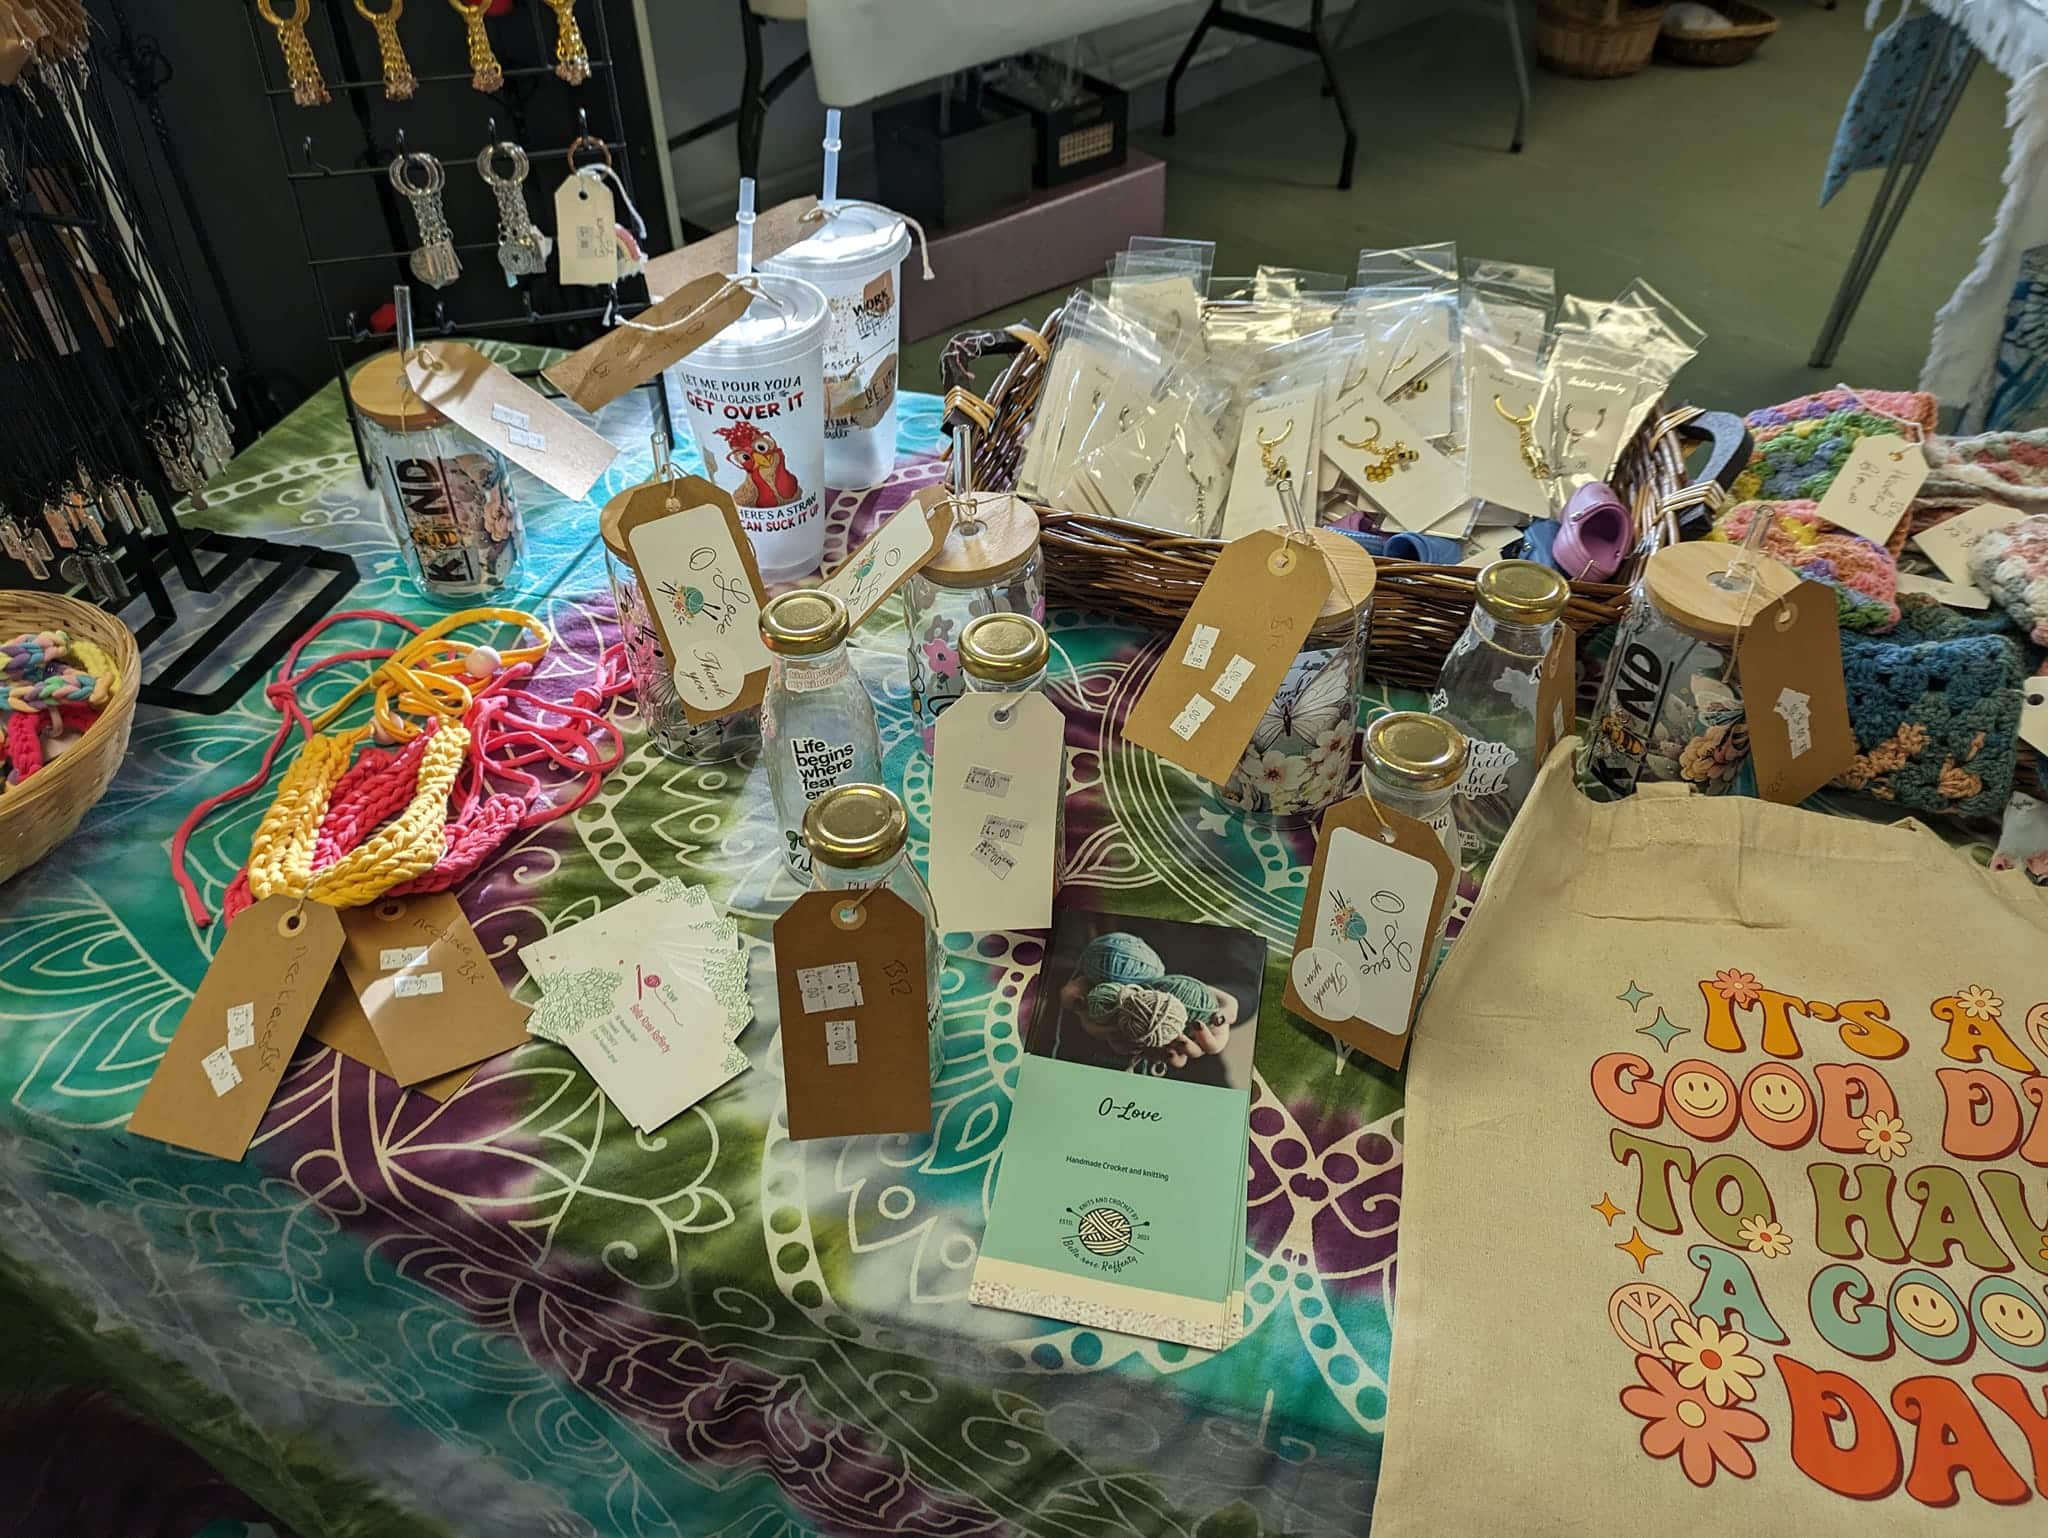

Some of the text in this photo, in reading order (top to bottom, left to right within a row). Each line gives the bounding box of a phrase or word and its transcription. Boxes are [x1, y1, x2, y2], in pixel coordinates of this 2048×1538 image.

[681, 371, 801, 393] LET ME POUR YOU A
[686, 390, 804, 420] GET OVER IT
[704, 390, 776, 405] TALL GLASS OF
[766, 518, 796, 532] SUCK
[798, 512, 808, 525] IT
[809, 503, 820, 518] UP
[776, 510, 786, 518] A
[787, 491, 817, 515] STRAW
[792, 739, 826, 754] Life
[795, 743, 854, 767] begins
[799, 759, 853, 778] where
[802, 776, 837, 791] fear
[1698, 980, 2042, 1075] IT'S A
[1098, 1097, 1163, 1121] O-Love
[1590, 1052, 2048, 1168] GOOD D
[1065, 1155, 1102, 1169] Handmade
[1129, 1167, 1142, 1176] and
[1142, 1169, 1169, 1182] knitting
[1609, 1128, 1778, 1248] TO
[1688, 1244, 2048, 1373] A GOO
